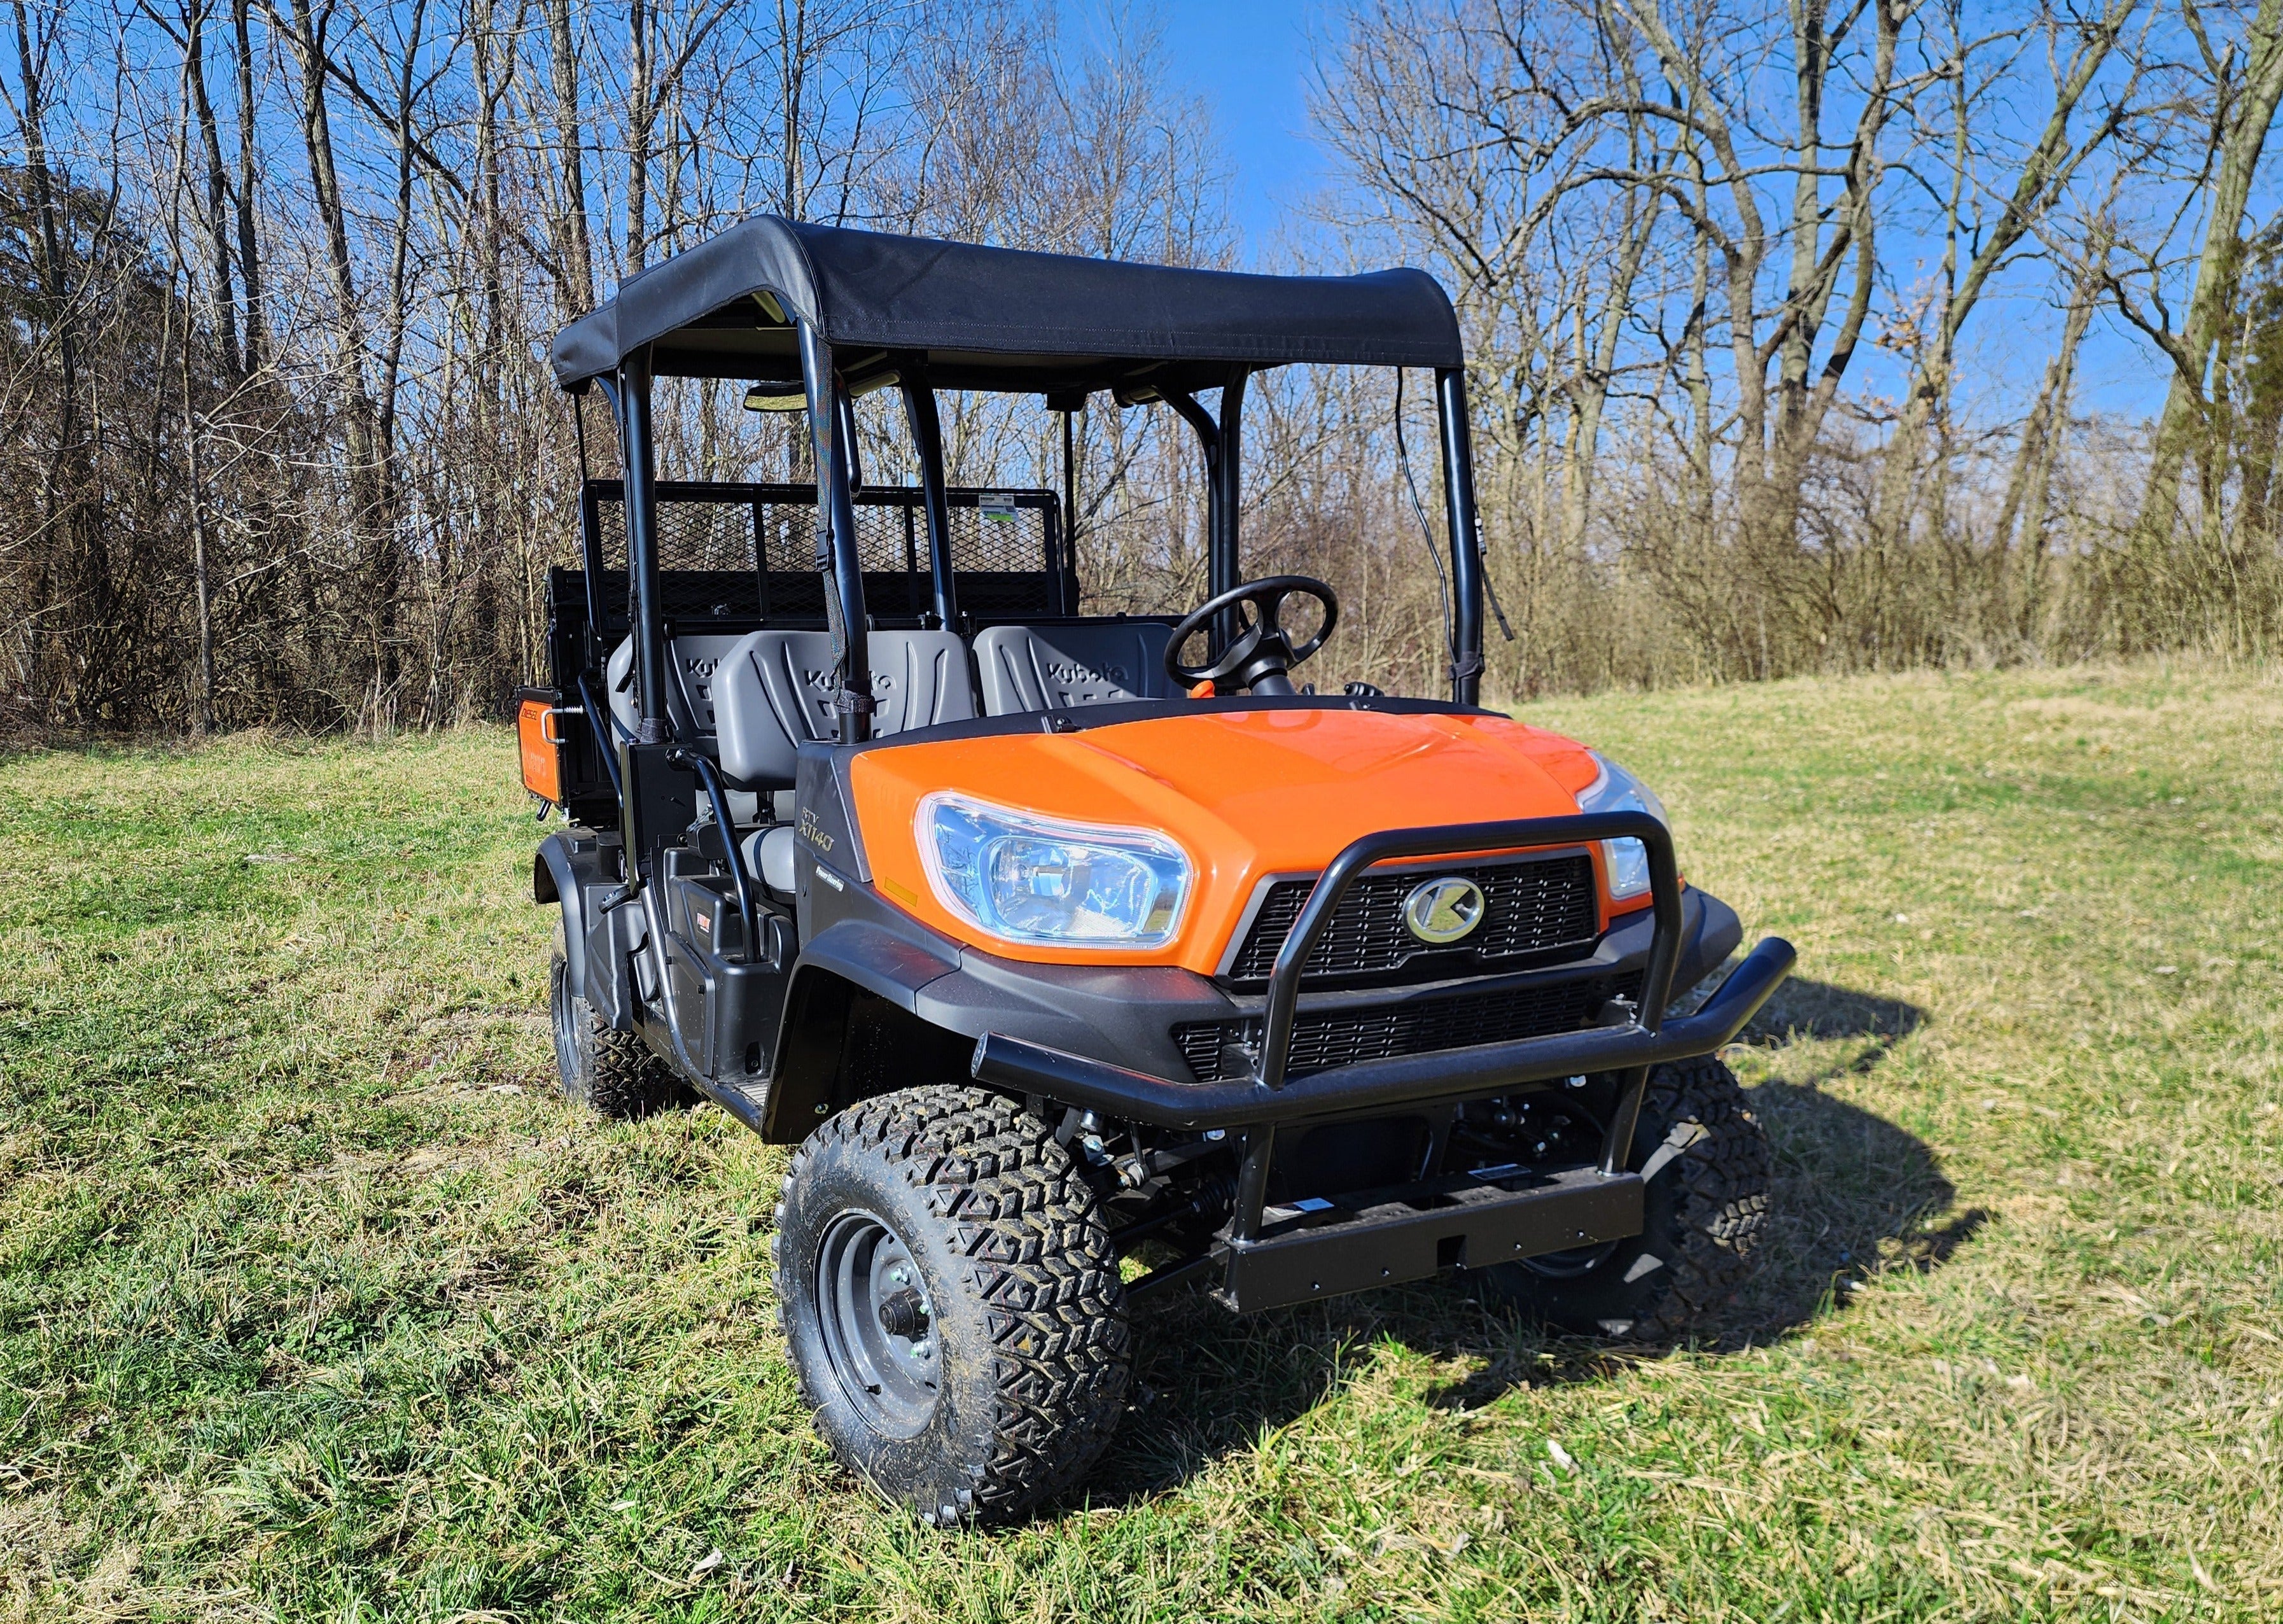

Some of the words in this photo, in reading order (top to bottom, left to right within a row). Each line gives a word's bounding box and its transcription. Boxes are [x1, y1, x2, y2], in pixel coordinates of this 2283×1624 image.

[1047, 662, 1128, 684] Kubota
[802, 806, 820, 825] RTV
[799, 818, 835, 852] X1140
[816, 866, 828, 879] Power
[827, 874, 844, 892] Steering
